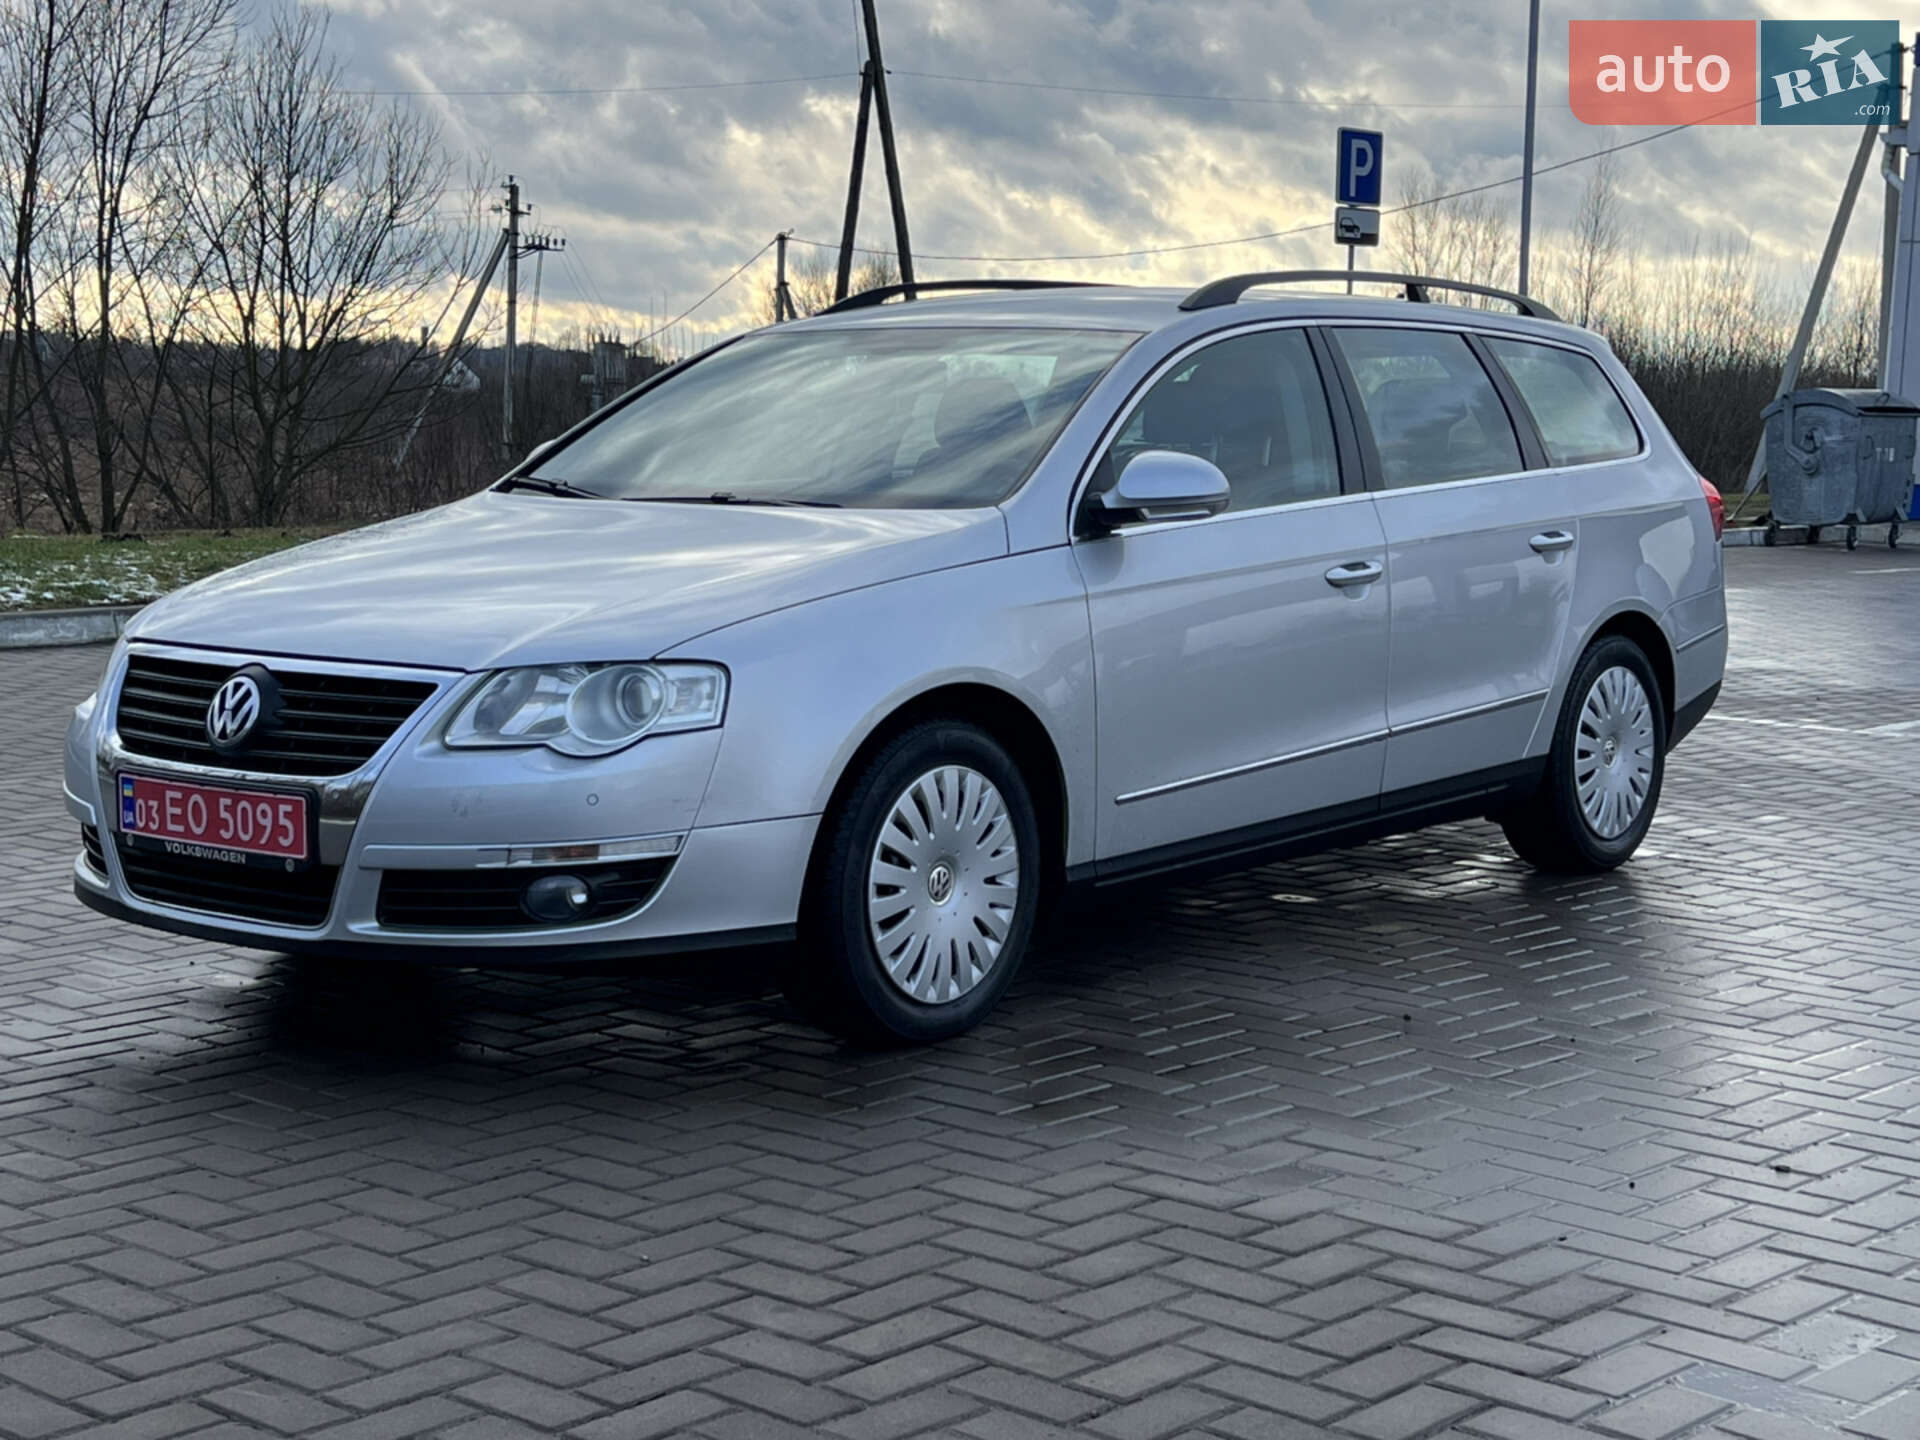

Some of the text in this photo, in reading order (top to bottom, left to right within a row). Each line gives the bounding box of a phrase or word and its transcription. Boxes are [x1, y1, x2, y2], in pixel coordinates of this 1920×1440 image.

[1349, 138, 1374, 198] P
[135, 790, 295, 847] 03 EO 5095
[165, 842, 246, 864] VOLKSWAGEN
